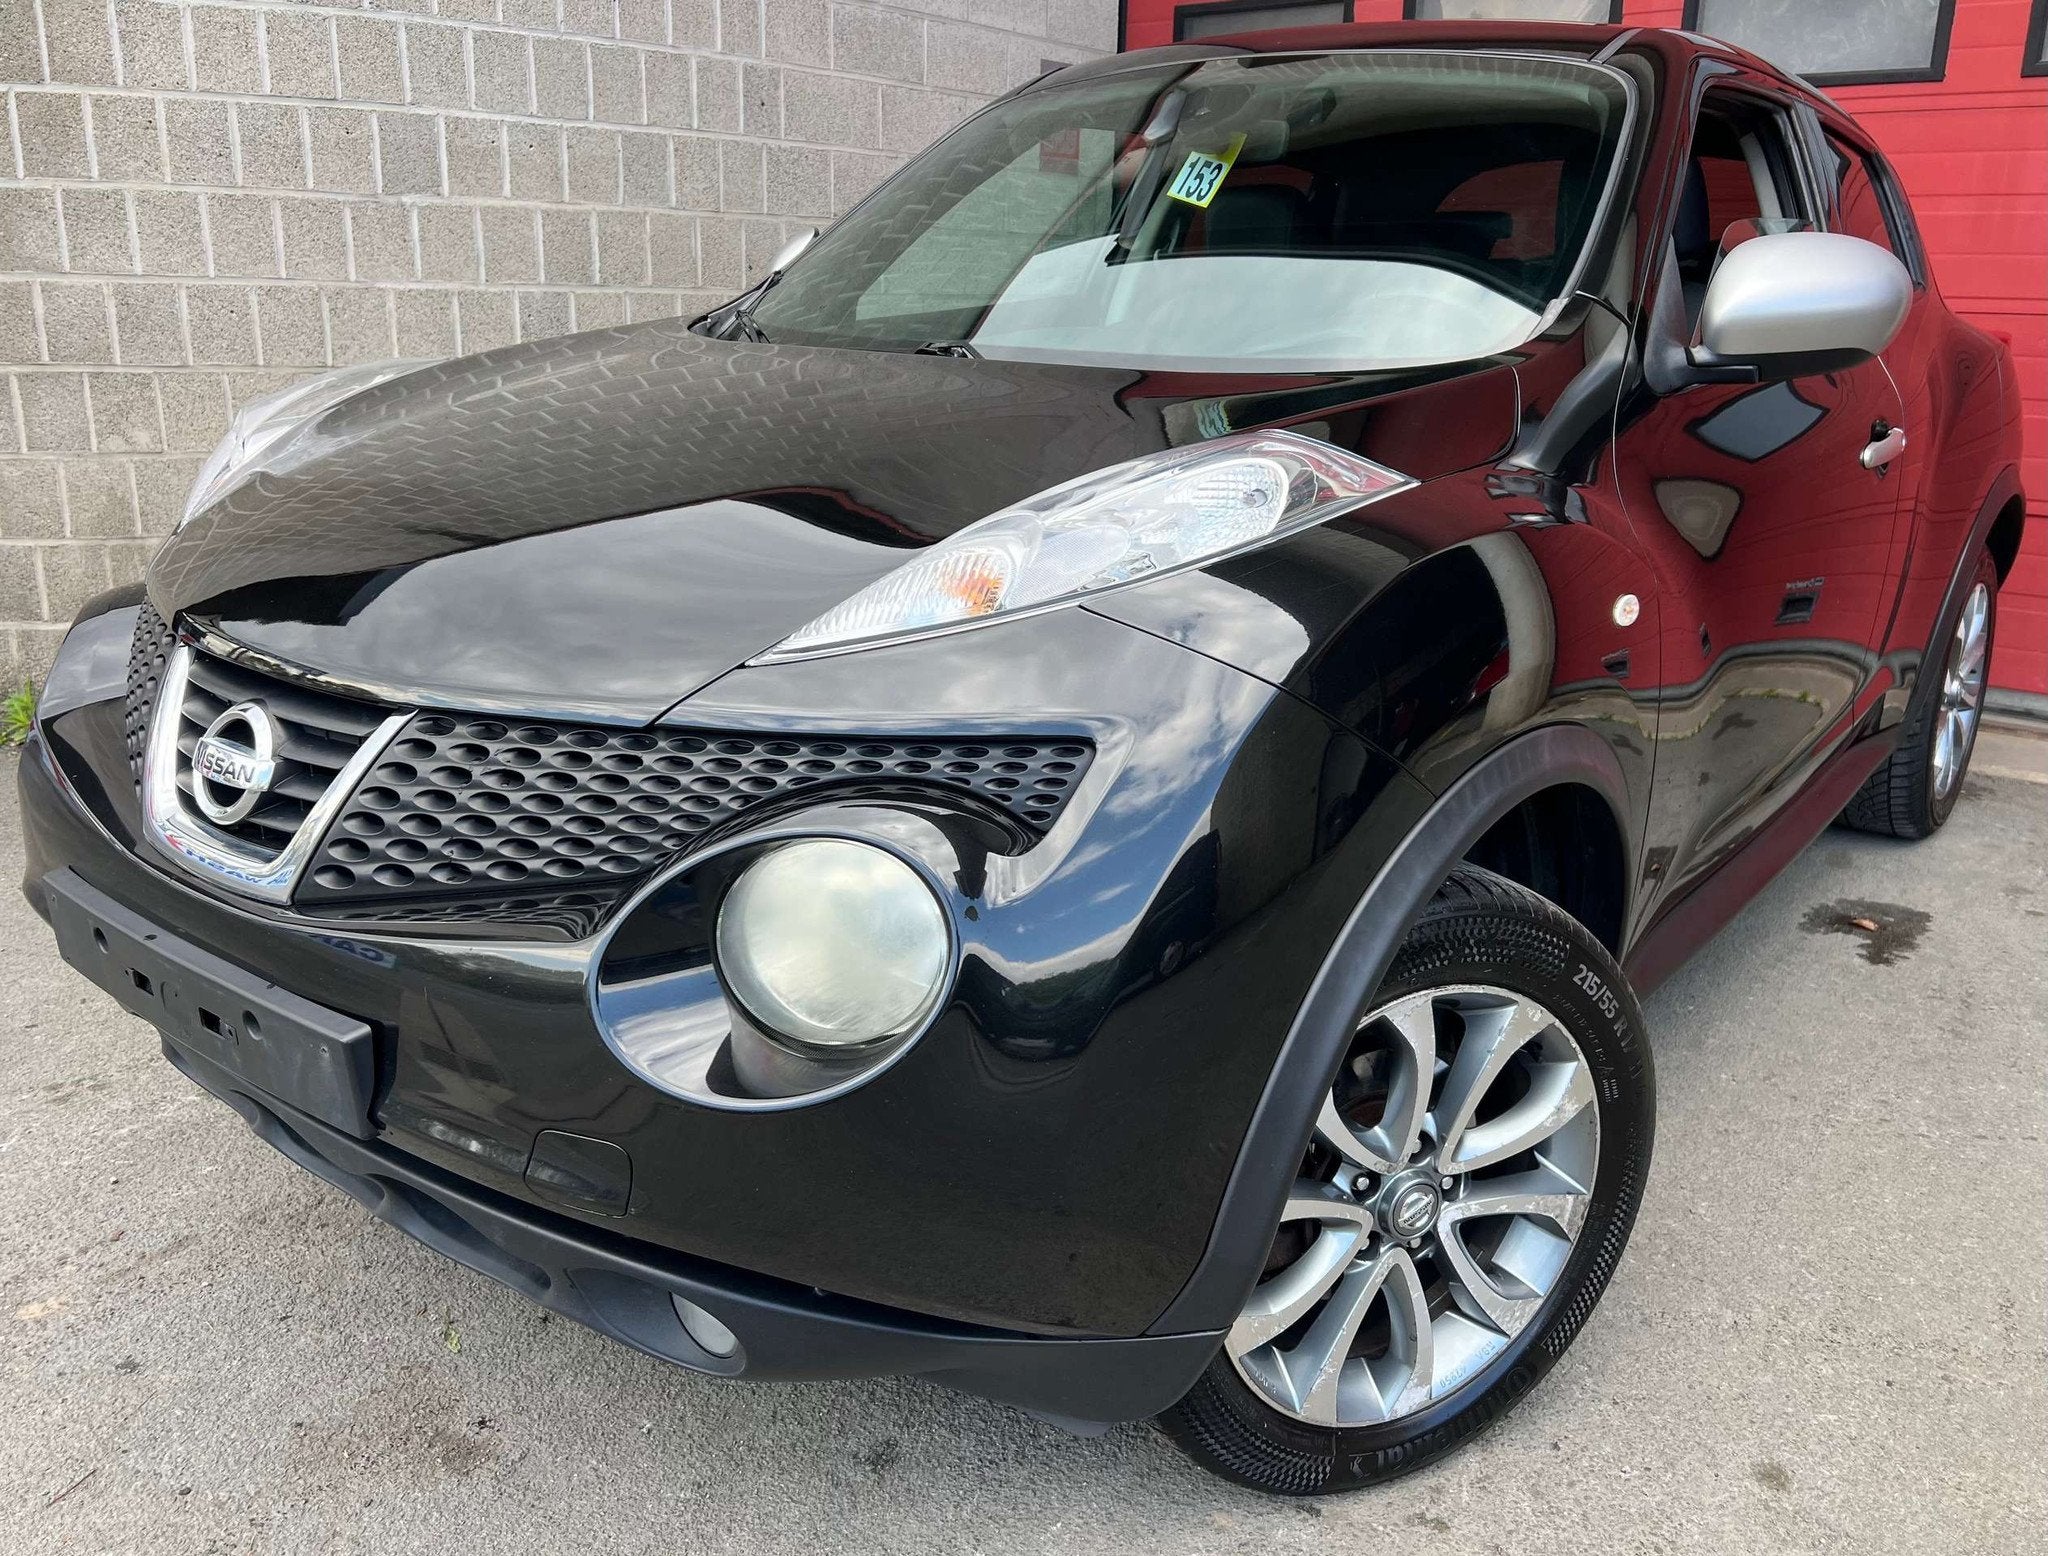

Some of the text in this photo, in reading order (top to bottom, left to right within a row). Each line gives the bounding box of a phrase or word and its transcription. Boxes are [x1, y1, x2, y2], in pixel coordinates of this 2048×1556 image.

[1177, 156, 1223, 202] 153
[196, 742, 256, 783] NISSAN
[1572, 963, 1619, 1019] 215/55
